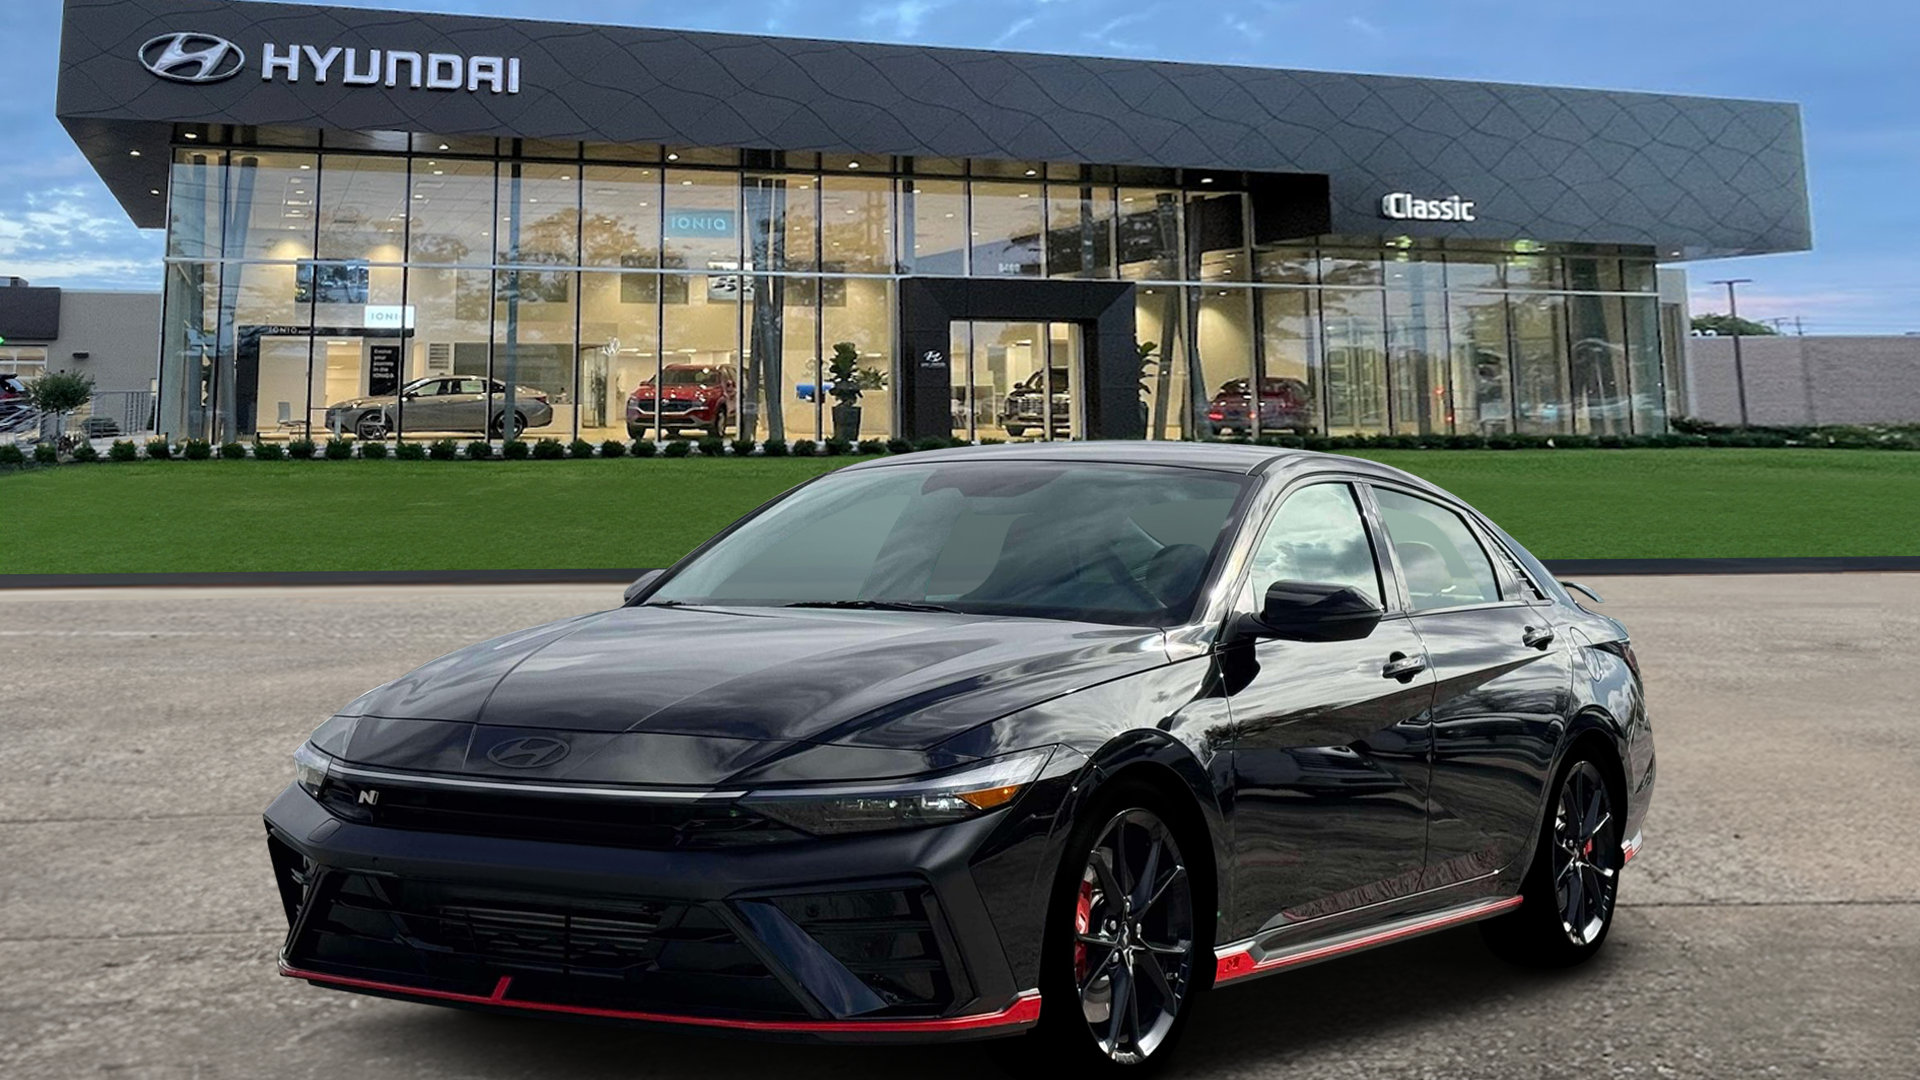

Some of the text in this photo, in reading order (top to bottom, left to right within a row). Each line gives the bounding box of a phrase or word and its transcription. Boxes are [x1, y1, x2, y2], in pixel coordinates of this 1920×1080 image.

[262, 43, 520, 94] HYUNDAI
[1382, 192, 1476, 222] Classic
[671, 216, 727, 231] IONIQ
[371, 312, 404, 321] IONI
[358, 790, 379, 806] N
